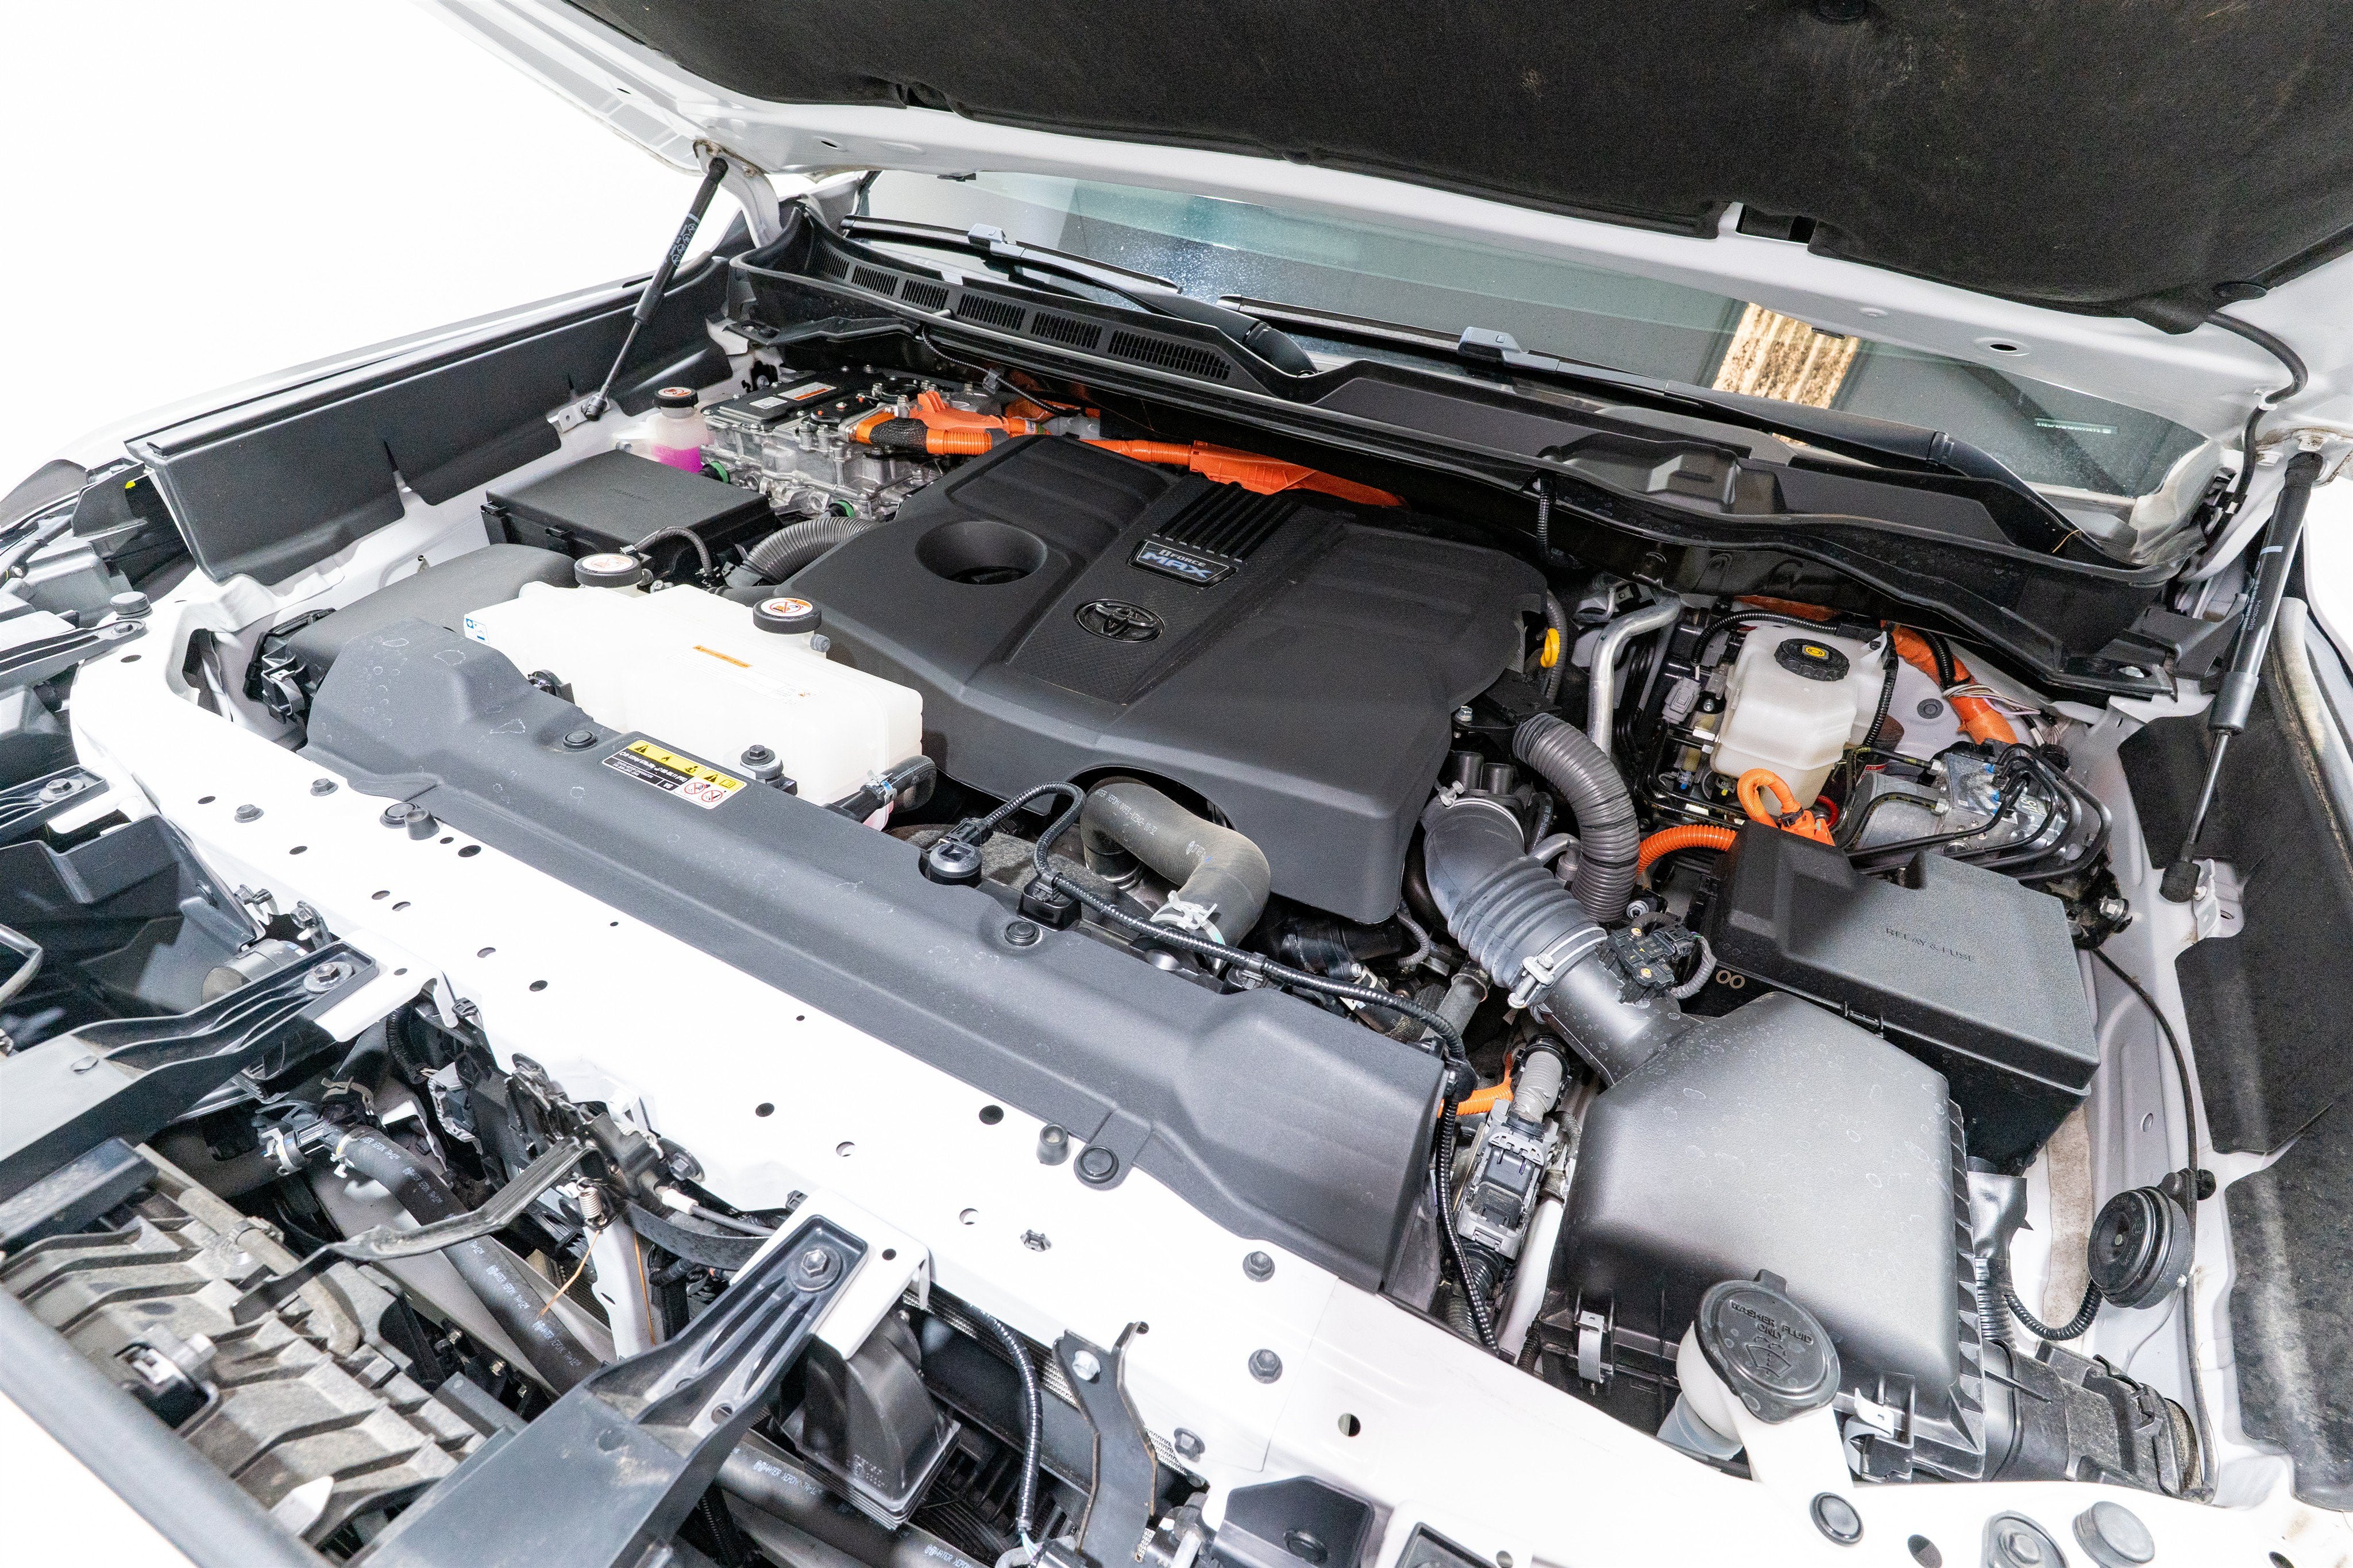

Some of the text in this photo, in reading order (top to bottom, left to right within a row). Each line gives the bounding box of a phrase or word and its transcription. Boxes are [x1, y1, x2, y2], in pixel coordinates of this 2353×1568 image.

[1141, 551, 1212, 578] MAX
[1730, 1300, 1814, 1345] WASHER FLUID
[1756, 1323, 1783, 1341] ONLY
